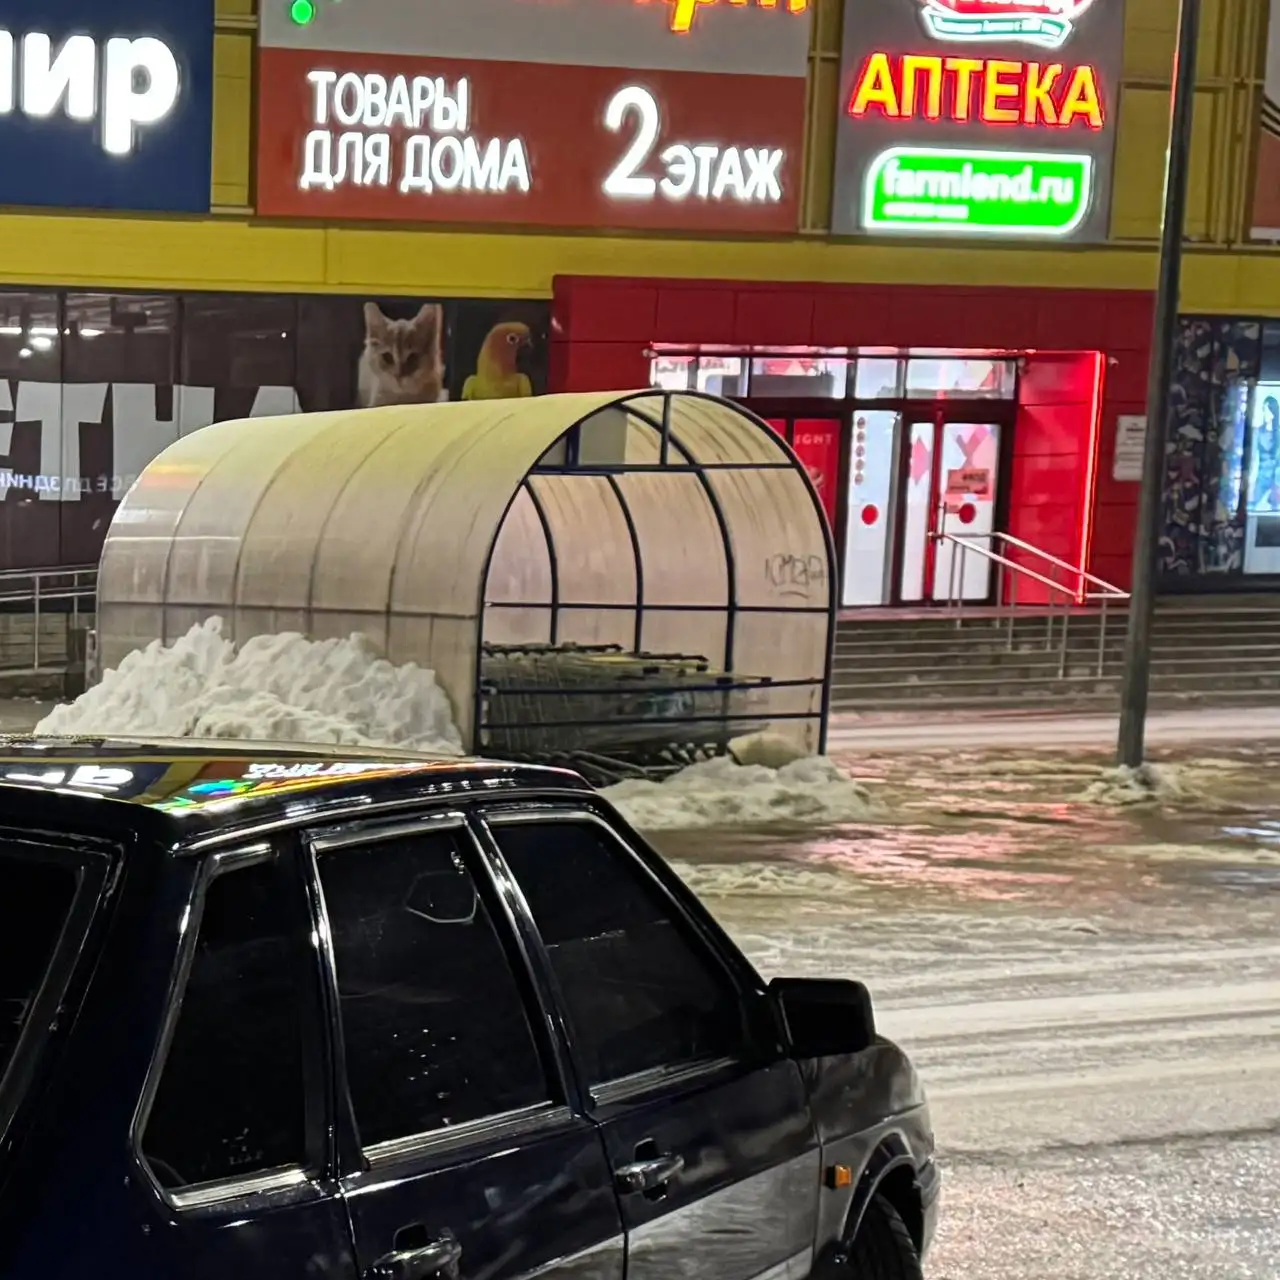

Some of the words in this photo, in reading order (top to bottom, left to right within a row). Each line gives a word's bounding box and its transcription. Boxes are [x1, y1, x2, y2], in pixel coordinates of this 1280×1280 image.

[307, 70, 469, 131] ТОВАРЫ
[849, 52, 1105, 129] АПТЕКА
[300, 130, 392, 191] ДЛЯ
[400, 135, 530, 193] ДОМА
[603, 85, 660, 197] 2
[660, 145, 782, 201] ЭТАЖ
